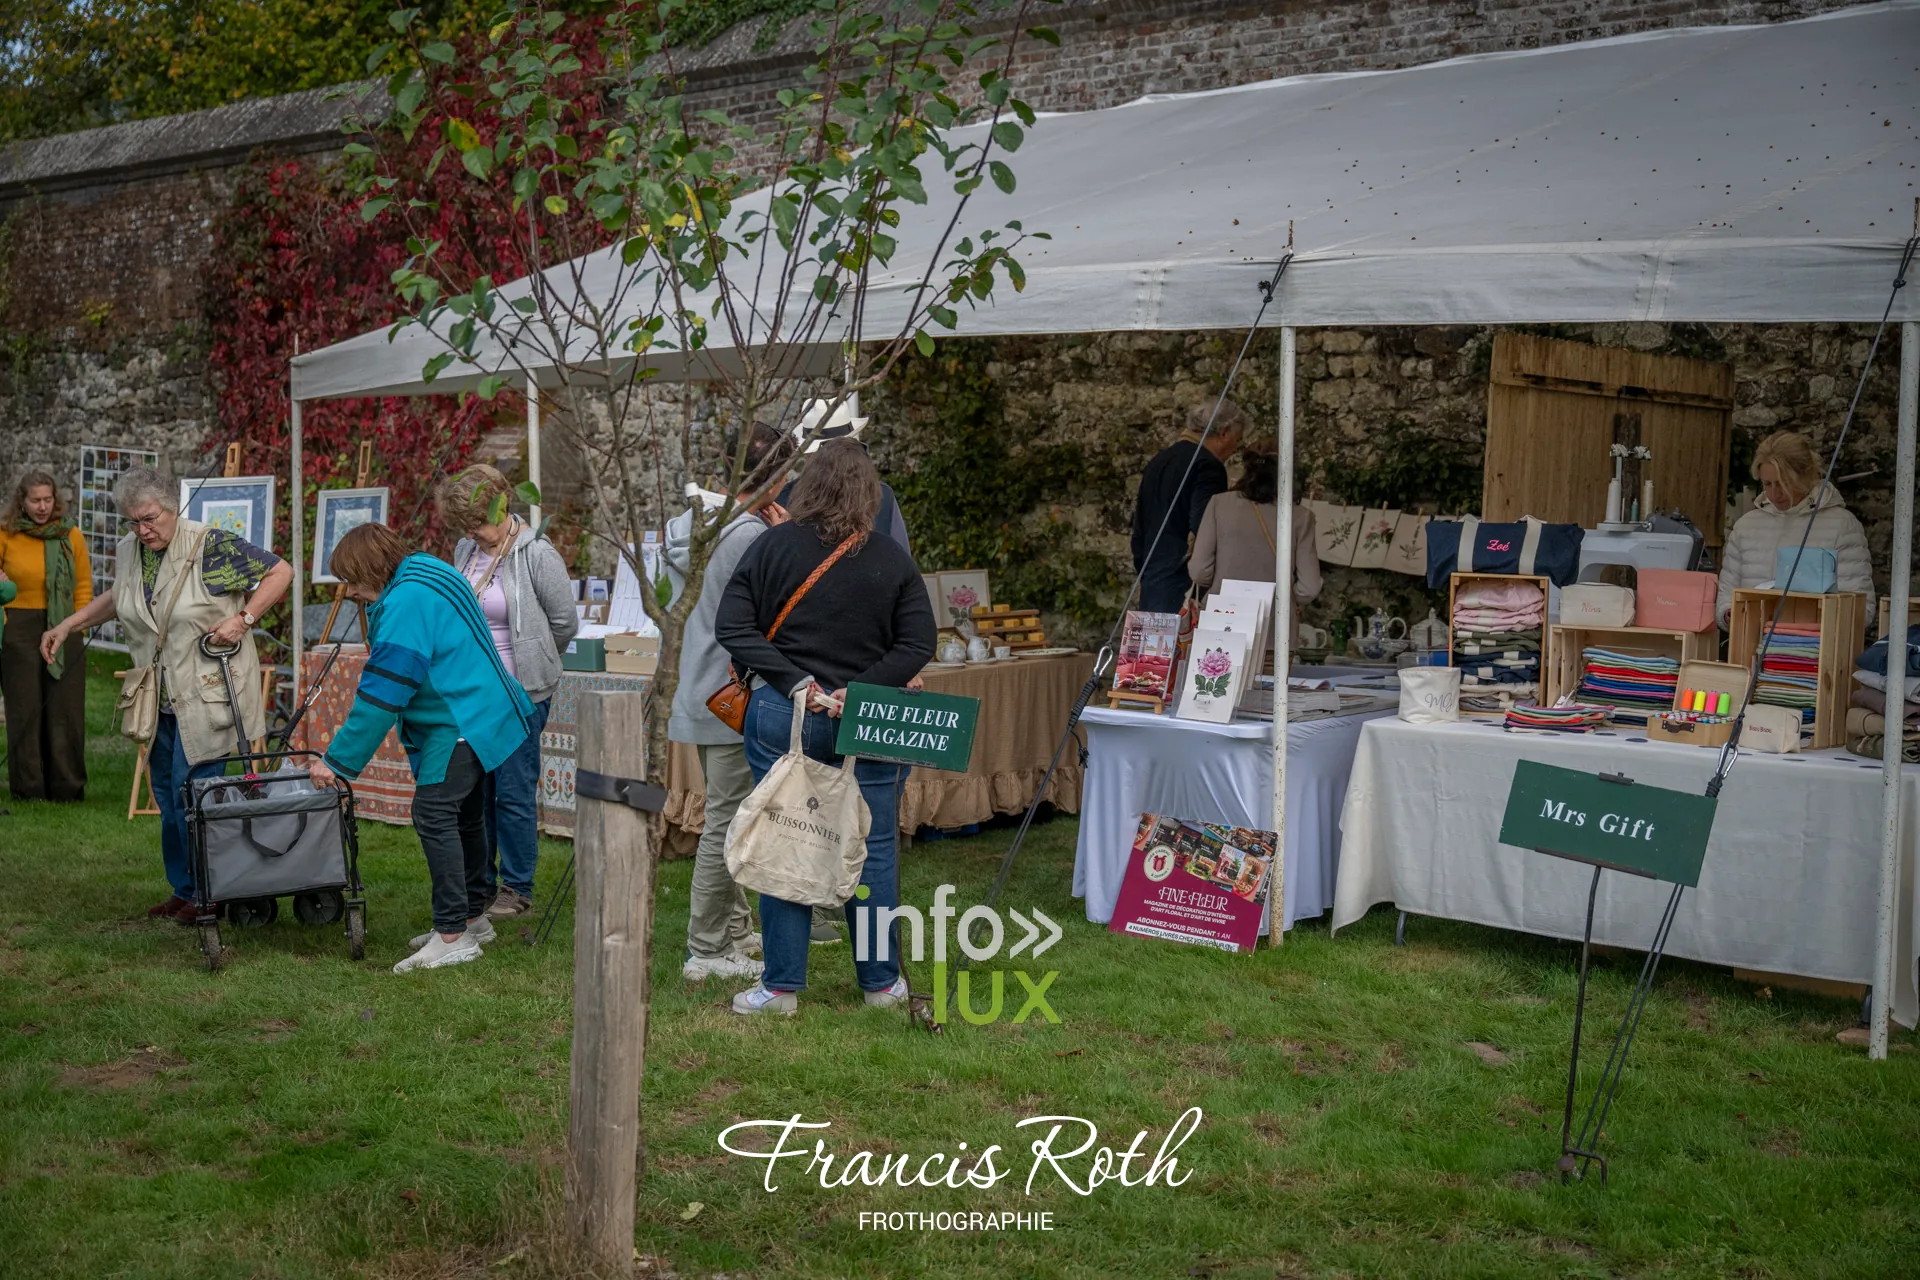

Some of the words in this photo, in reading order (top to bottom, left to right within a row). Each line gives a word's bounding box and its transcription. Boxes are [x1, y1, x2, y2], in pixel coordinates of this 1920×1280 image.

[1486, 539, 1511, 551] Zoé
[857, 701, 899, 721] FINE
[900, 706, 960, 729] FLEUR
[854, 724, 949, 752] MAGAZINE
[1538, 798, 1588, 828] Mrs
[1598, 813, 1657, 842] Gift
[1143, 899, 1169, 909] MAGAZINE
[1176, 904, 1207, 916] DÉCORATION
[1158, 886, 1188, 905] FINE
[1188, 891, 1229, 911] FLEUR
[1150, 906, 1165, 914] D'ART
[1165, 908, 1183, 917] FLORAL
[1190, 913, 1205, 921] D'ART
[1132, 925, 1160, 936] NUMÉROS
[1160, 931, 1179, 940] LIVRÉS
[1179, 935, 1193, 944] CHEZ
[1136, 916, 1186, 932] ABONNEZ-VOUS
[1186, 925, 1217, 937] PENDANT
